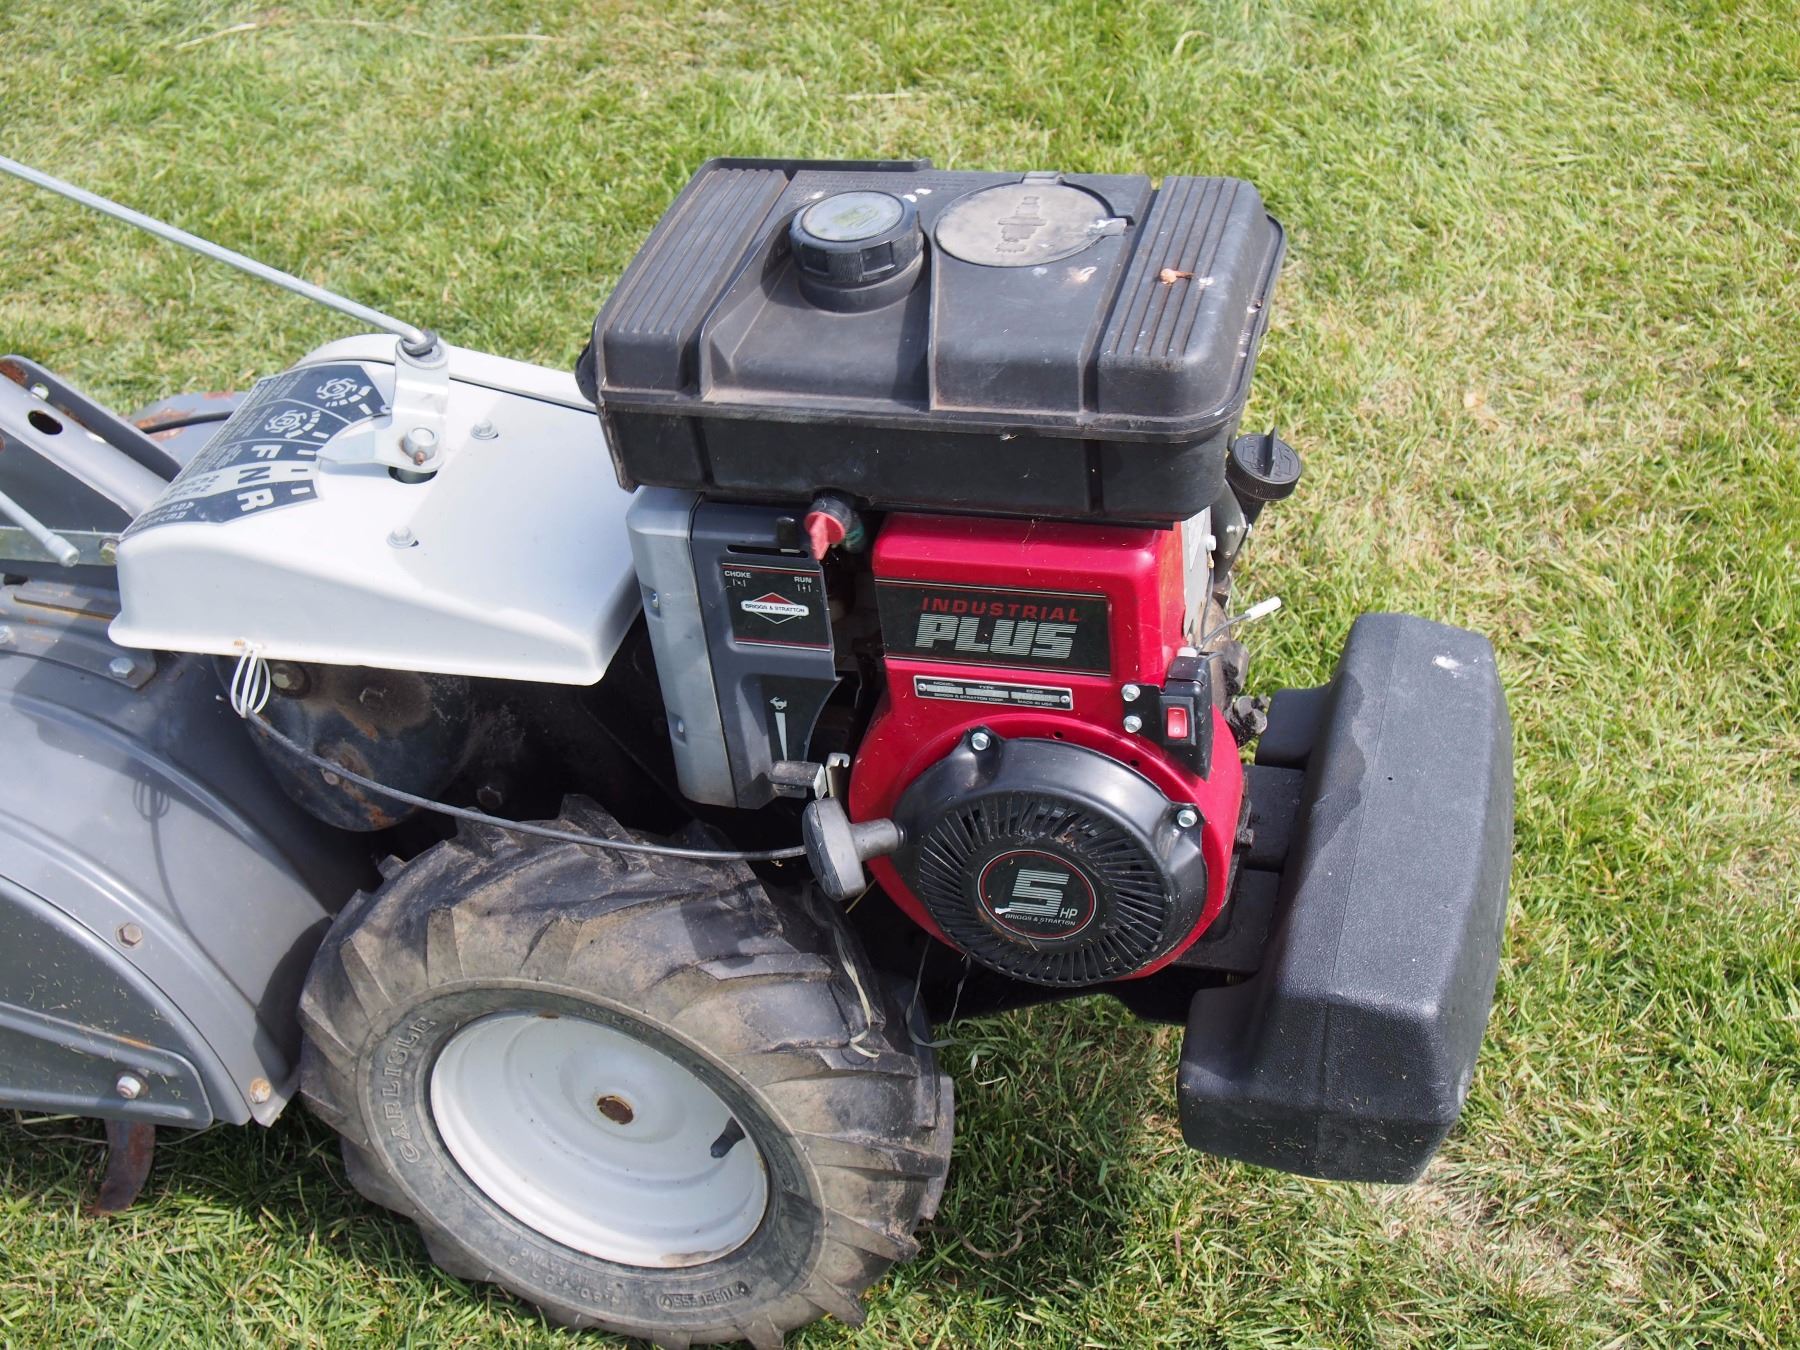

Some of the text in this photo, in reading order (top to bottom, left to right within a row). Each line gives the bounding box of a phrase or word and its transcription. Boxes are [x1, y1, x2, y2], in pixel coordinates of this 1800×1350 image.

[251, 444, 282, 458] F
[237, 466, 271, 484] N
[237, 488, 274, 512] R
[724, 570, 751, 579] CHOKE
[794, 576, 812, 584] RUN
[745, 603, 768, 611] BRIGGS
[775, 605, 805, 613] STRATTON
[921, 597, 1082, 622] INDUSTRIAL
[914, 613, 1078, 659] PLUS
[1009, 869, 1070, 917] 5
[1005, 913, 1032, 921] BRIGGS
[1040, 917, 1076, 926] STRATTON
[1060, 907, 1078, 919] HP
[382, 1016, 437, 1164] CARLISLE
